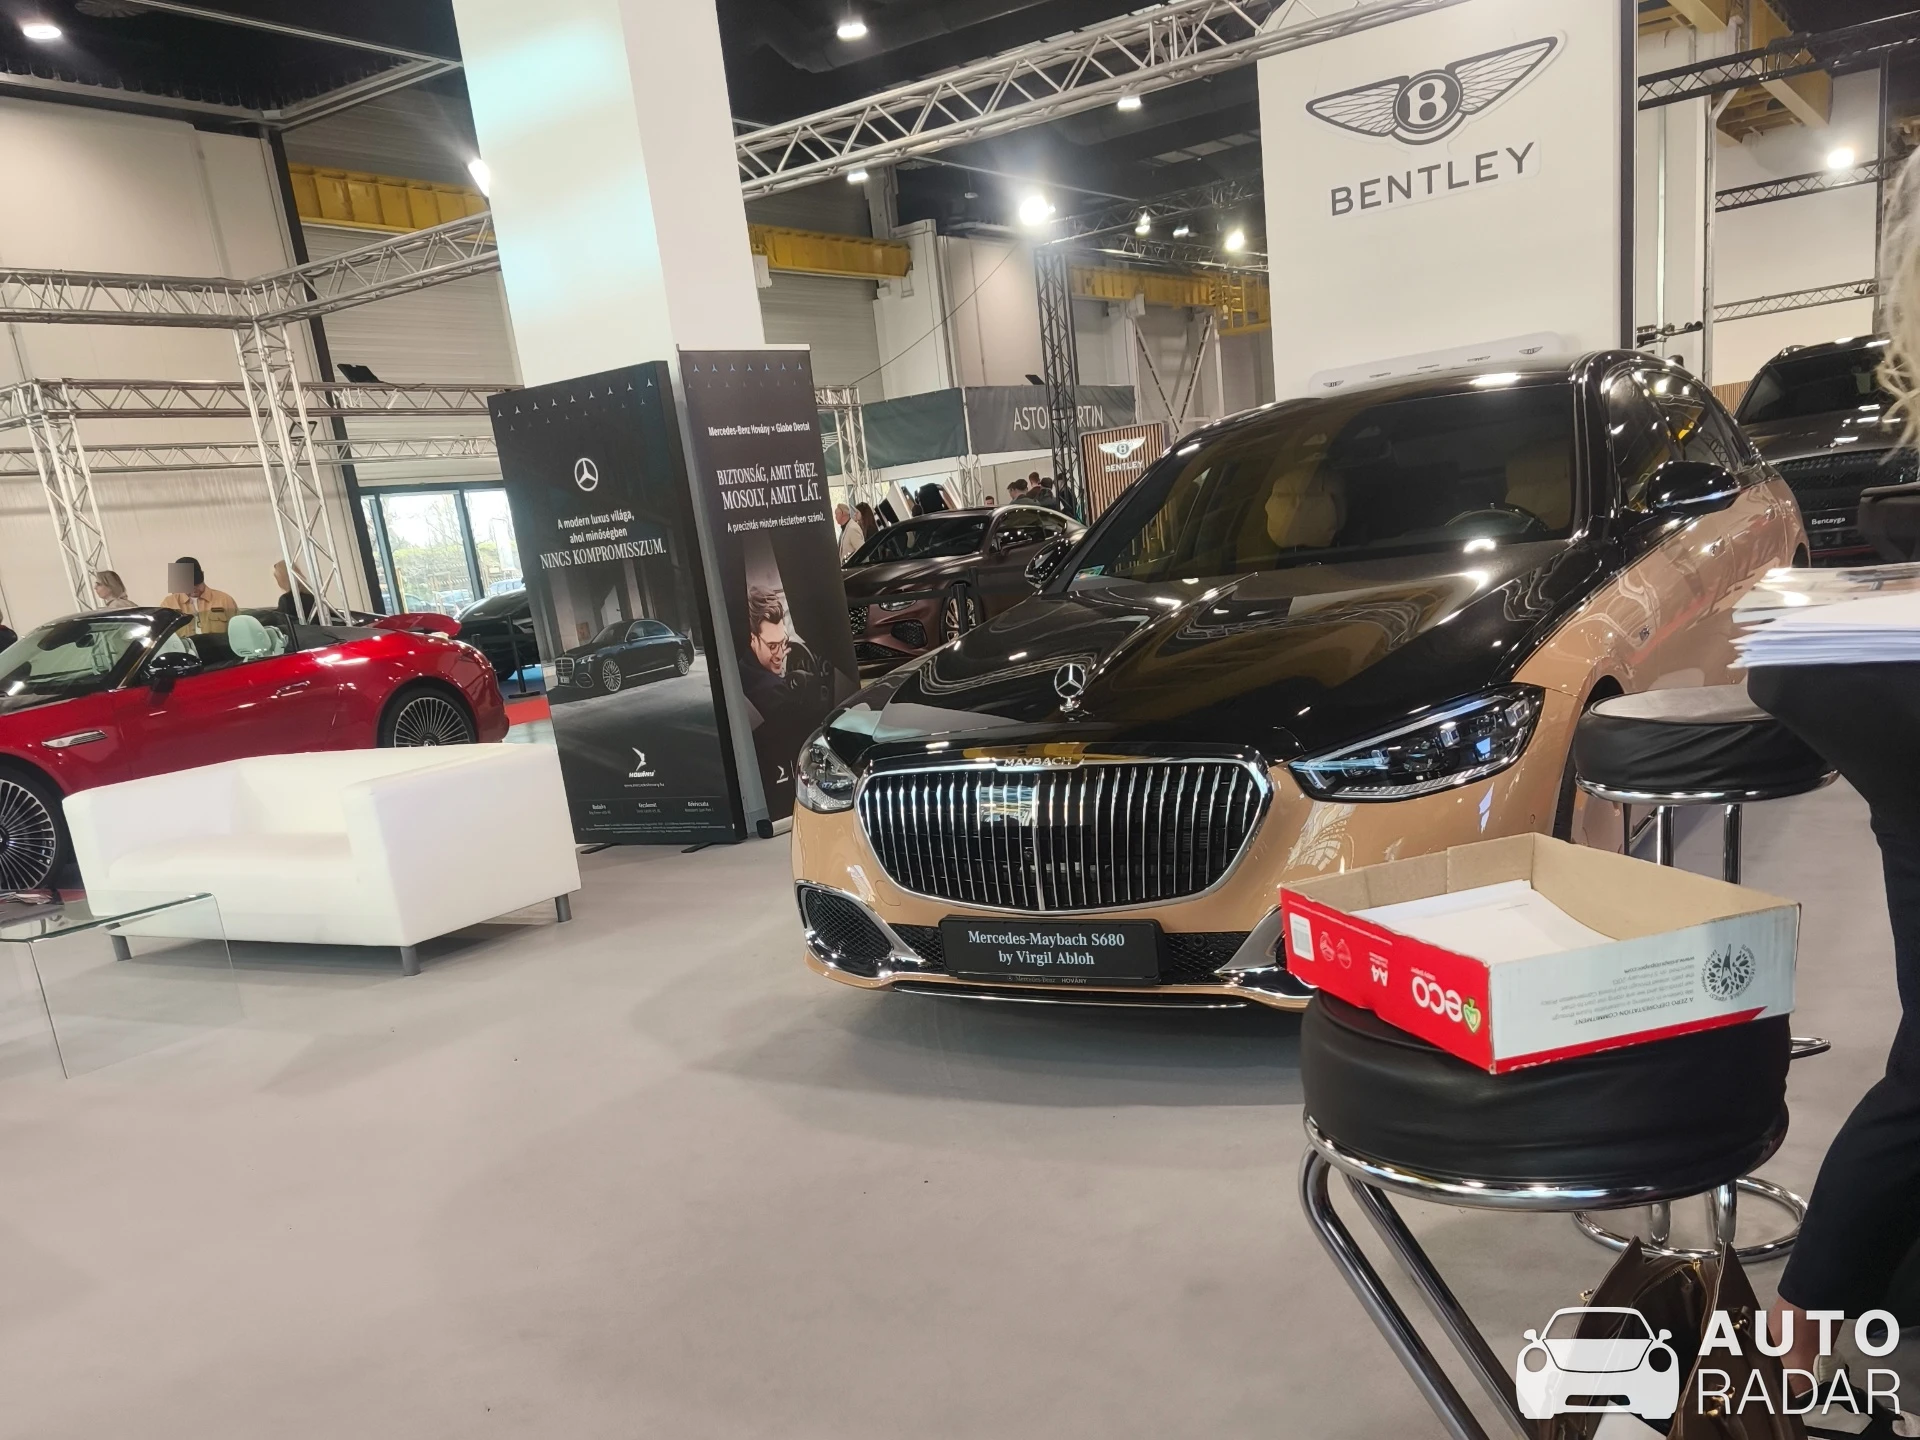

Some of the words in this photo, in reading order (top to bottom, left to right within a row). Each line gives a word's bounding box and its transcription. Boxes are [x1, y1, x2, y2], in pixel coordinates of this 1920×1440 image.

[1331, 142, 1534, 216] BENTLEY
[708, 425, 750, 437] Mercedes-Benz
[776, 422, 792, 433] Globe
[793, 421, 810, 432] Dental
[716, 463, 769, 485] BIZTONSÁG,
[770, 464, 792, 481] AMIT
[794, 460, 818, 479] ÉREZ.
[1105, 461, 1143, 473] BENTLEY
[721, 487, 769, 510] MOSOLY,
[770, 484, 797, 505] AMIT
[799, 479, 822, 502] LÁT.
[557, 519, 563, 530] A
[564, 516, 591, 529] modern
[591, 513, 610, 524] luxus
[610, 509, 635, 523] világa,
[727, 523, 733, 533] A
[569, 531, 585, 544] ahol
[586, 527, 628, 542] minőségben
[539, 550, 572, 570] NINCS
[572, 537, 667, 565] KOMPROMISSZUM.
[1003, 756, 1073, 767] MAYBACH
[967, 930, 1088, 948] Mercedes-Maybach
[1091, 933, 1125, 946] S680
[998, 950, 1014, 965] by
[1015, 951, 1053, 967] Virgil
[1056, 952, 1095, 965] Abloh
[1370, 965, 1389, 987] A4
[1411, 975, 1463, 1022] eco
[1671, 997, 1687, 1006] ZERO
